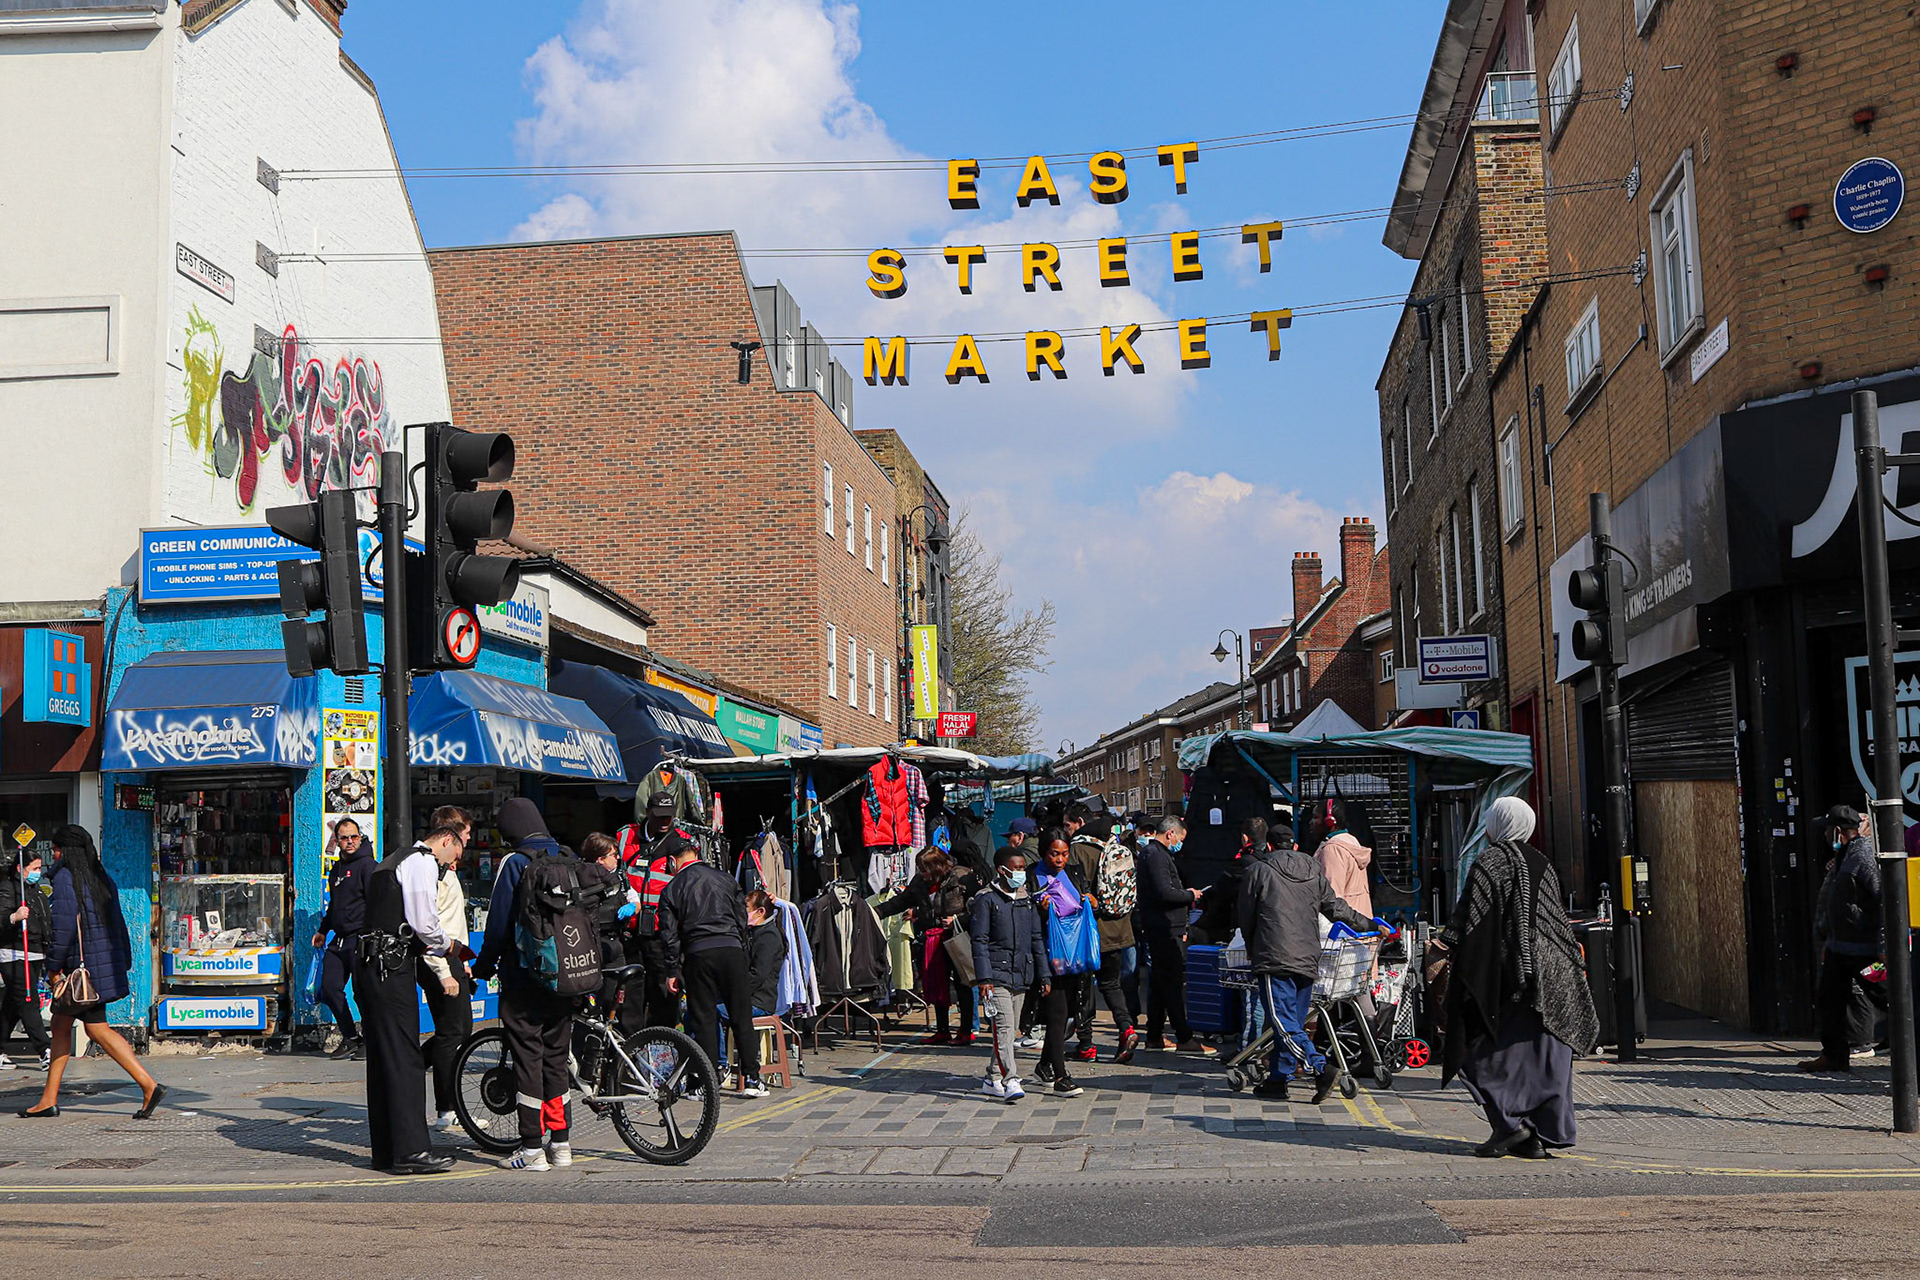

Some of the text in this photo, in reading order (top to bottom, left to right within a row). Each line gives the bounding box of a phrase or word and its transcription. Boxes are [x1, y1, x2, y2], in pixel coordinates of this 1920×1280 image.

[948, 141, 1200, 210] EAST
[1840, 176, 1897, 197] Charlie Chaplin
[178, 247, 198, 270] EAST
[199, 260, 226, 287] STREET
[865, 220, 1283, 300] STREET
[863, 307, 1293, 388] MARKET
[1691, 346, 1704, 371] EAST
[1703, 329, 1722, 360] STREET
[149, 540, 196, 554] GREEN
[156, 564, 188, 573] MOBILE
[189, 562, 216, 571] PHONE
[218, 561, 238, 570] SIMS
[169, 575, 216, 584] UNLOCKING
[224, 573, 250, 582] PARTS
[1628, 589, 1647, 620] KING
[1646, 584, 1654, 609] OF
[1653, 558, 1693, 605] TRAINERS
[1441, 664, 1484, 673] vodafone
[48, 697, 80, 717] GREGGS
[251, 705, 275, 718] 275
[752, 716, 766, 730] STORE
[942, 714, 971, 722] FRESH
[942, 721, 970, 729] HALAL
[944, 728, 968, 736] MEAT
[174, 954, 254, 973] Lycamobile
[170, 1005, 255, 1022] Lycamobile
